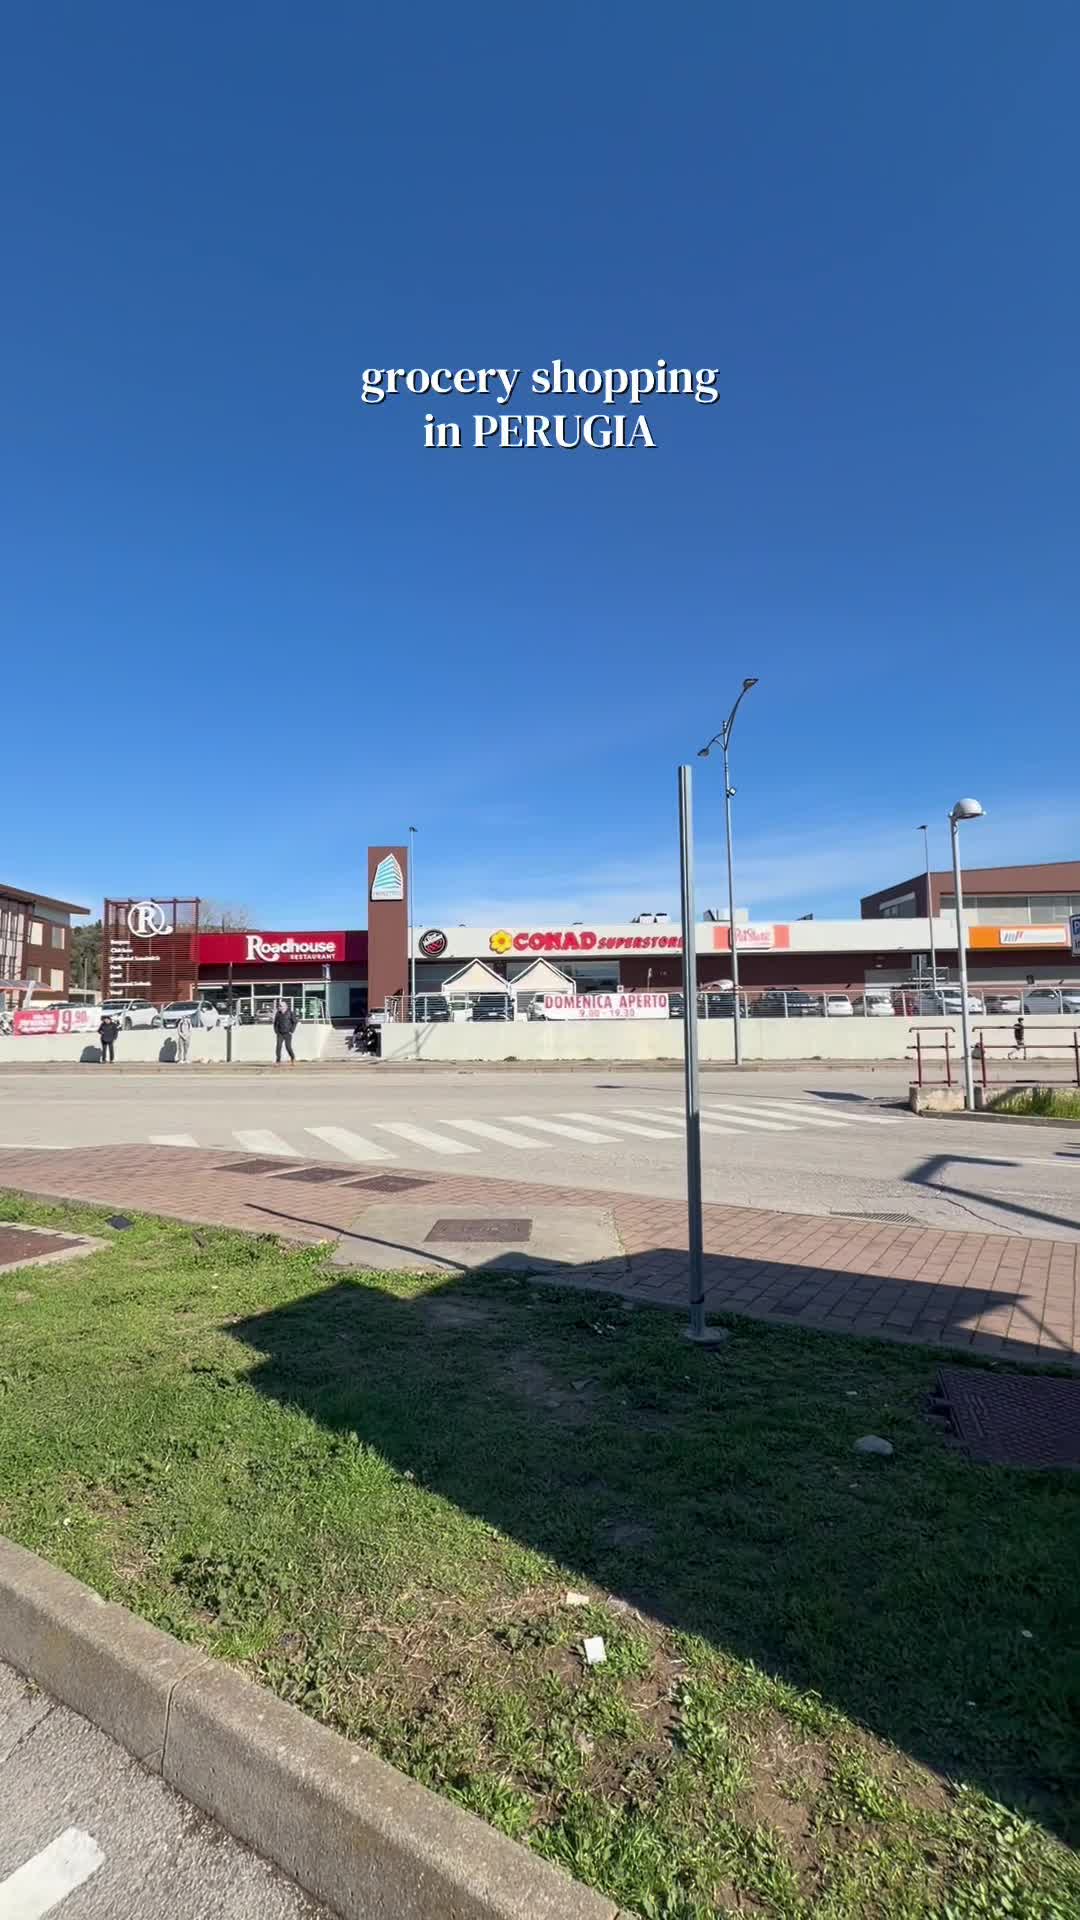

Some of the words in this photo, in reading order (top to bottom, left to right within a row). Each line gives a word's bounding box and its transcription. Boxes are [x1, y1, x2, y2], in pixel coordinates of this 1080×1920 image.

[246, 935, 336, 962] Roadhouse
[513, 931, 597, 950] CONAD
[545, 994, 612, 1009] DOMENICA
[620, 994, 667, 1008] APERTO
